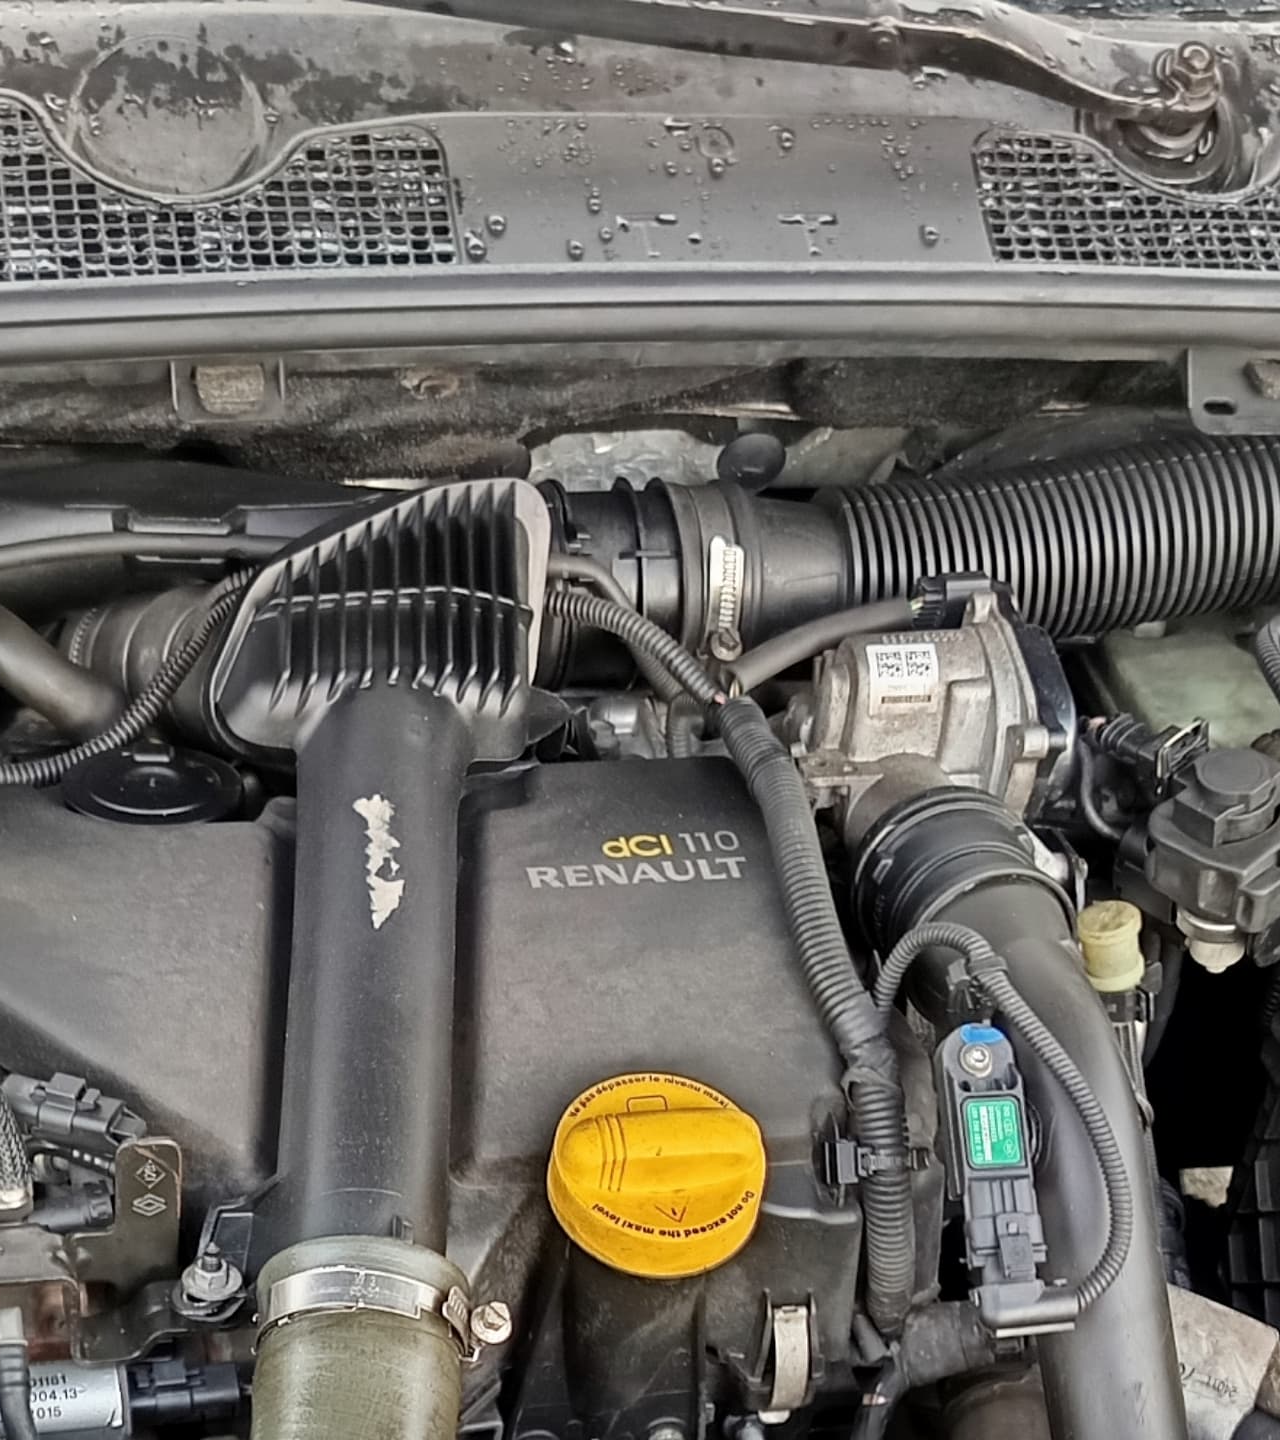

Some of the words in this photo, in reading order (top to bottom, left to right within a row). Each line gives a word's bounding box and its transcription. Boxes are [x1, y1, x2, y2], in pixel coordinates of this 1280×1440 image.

[678, 830, 740, 853] 110
[526, 857, 746, 889] RENAULT
[741, 1190, 755, 1203] Do
[592, 1203, 621, 1225] level
[726, 1203, 744, 1220] not
[622, 1219, 655, 1235] maxi
[659, 1229, 681, 1238] the
[683, 1216, 727, 1238] exceed
